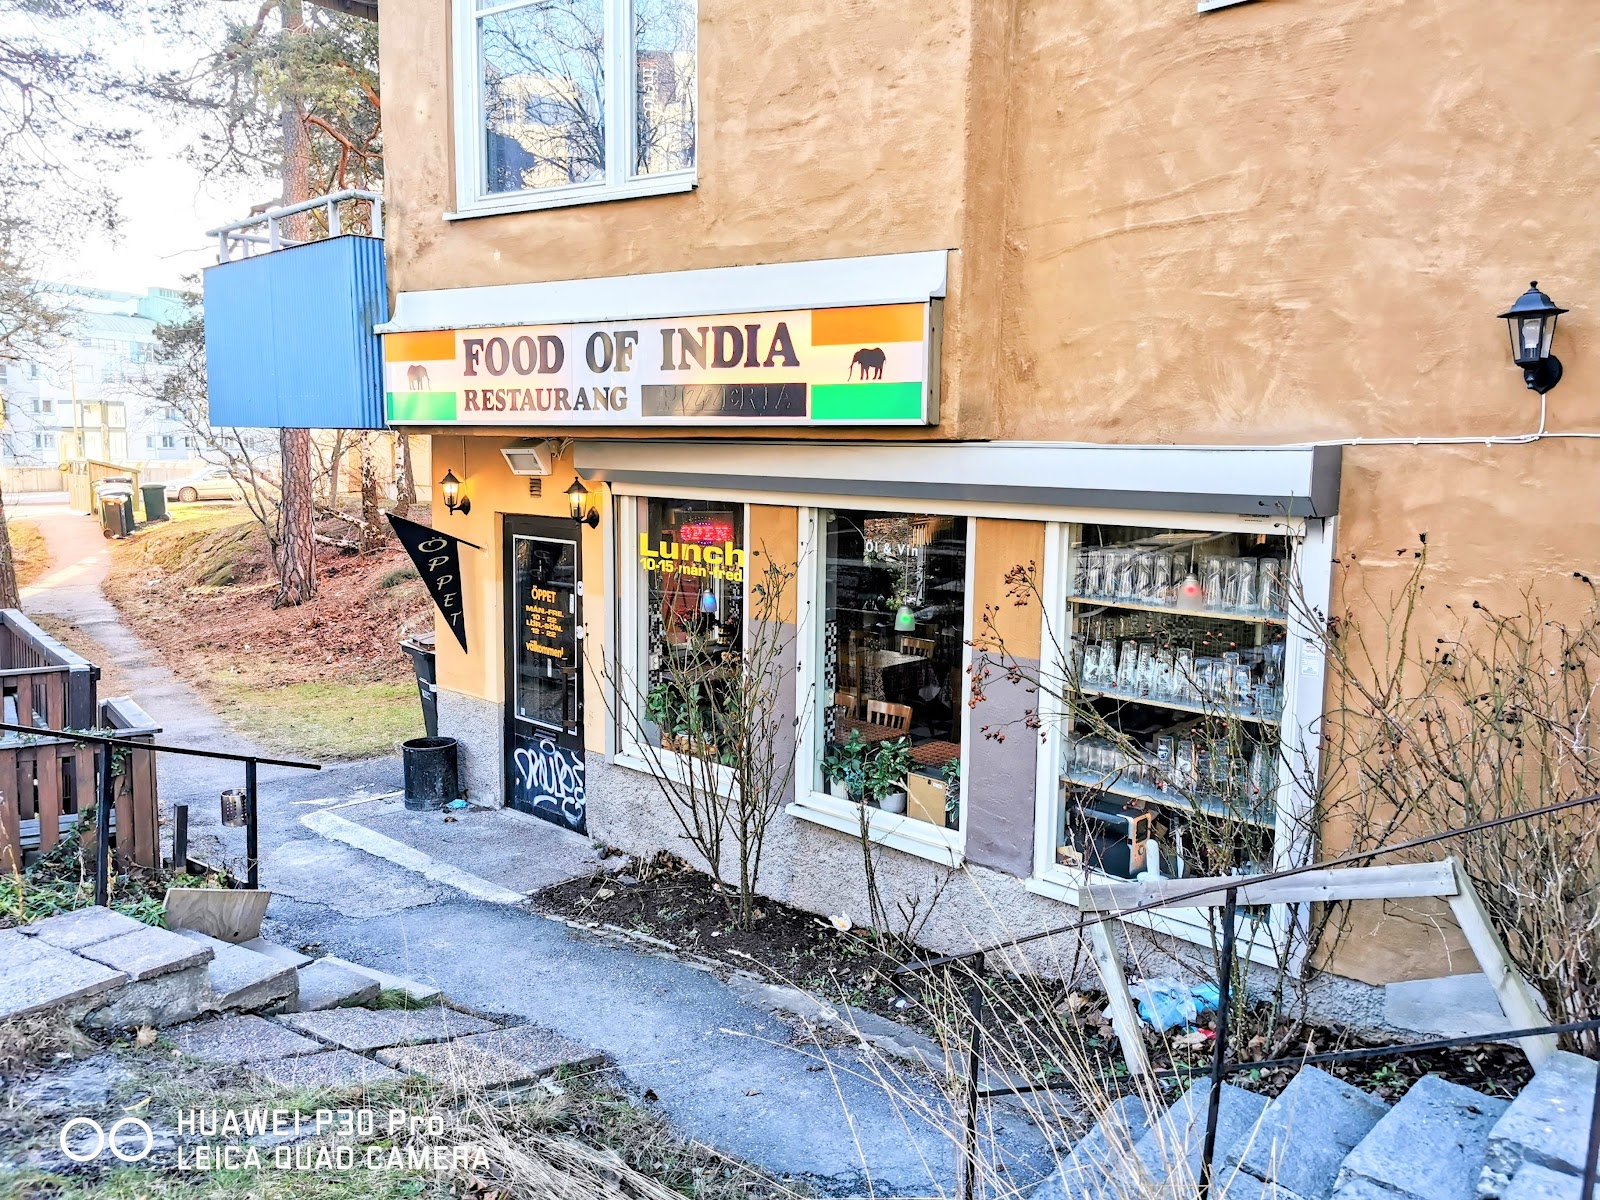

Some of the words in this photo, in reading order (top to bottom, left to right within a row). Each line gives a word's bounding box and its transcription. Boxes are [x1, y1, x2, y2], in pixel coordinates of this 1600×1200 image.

[463, 335, 565, 376] FOOD
[585, 330, 639, 374] OF
[660, 322, 801, 371] INDIA
[464, 386, 628, 412] RESTAURANG
[680, 524, 734, 542] OPEN
[640, 532, 744, 568] Lunch
[865, 539, 879, 553] Öl
[883, 543, 892, 554] &
[897, 544, 919, 557] Vin
[640, 557, 674, 573] 10-15
[678, 561, 707, 577] mån
[417, 536, 462, 627] ÖPPET
[531, 585, 557, 604] ÖPPET
[531, 613, 541, 621] 10
[547, 616, 558, 624] 22
[530, 627, 540, 635] 12
[546, 630, 557, 638] 22
